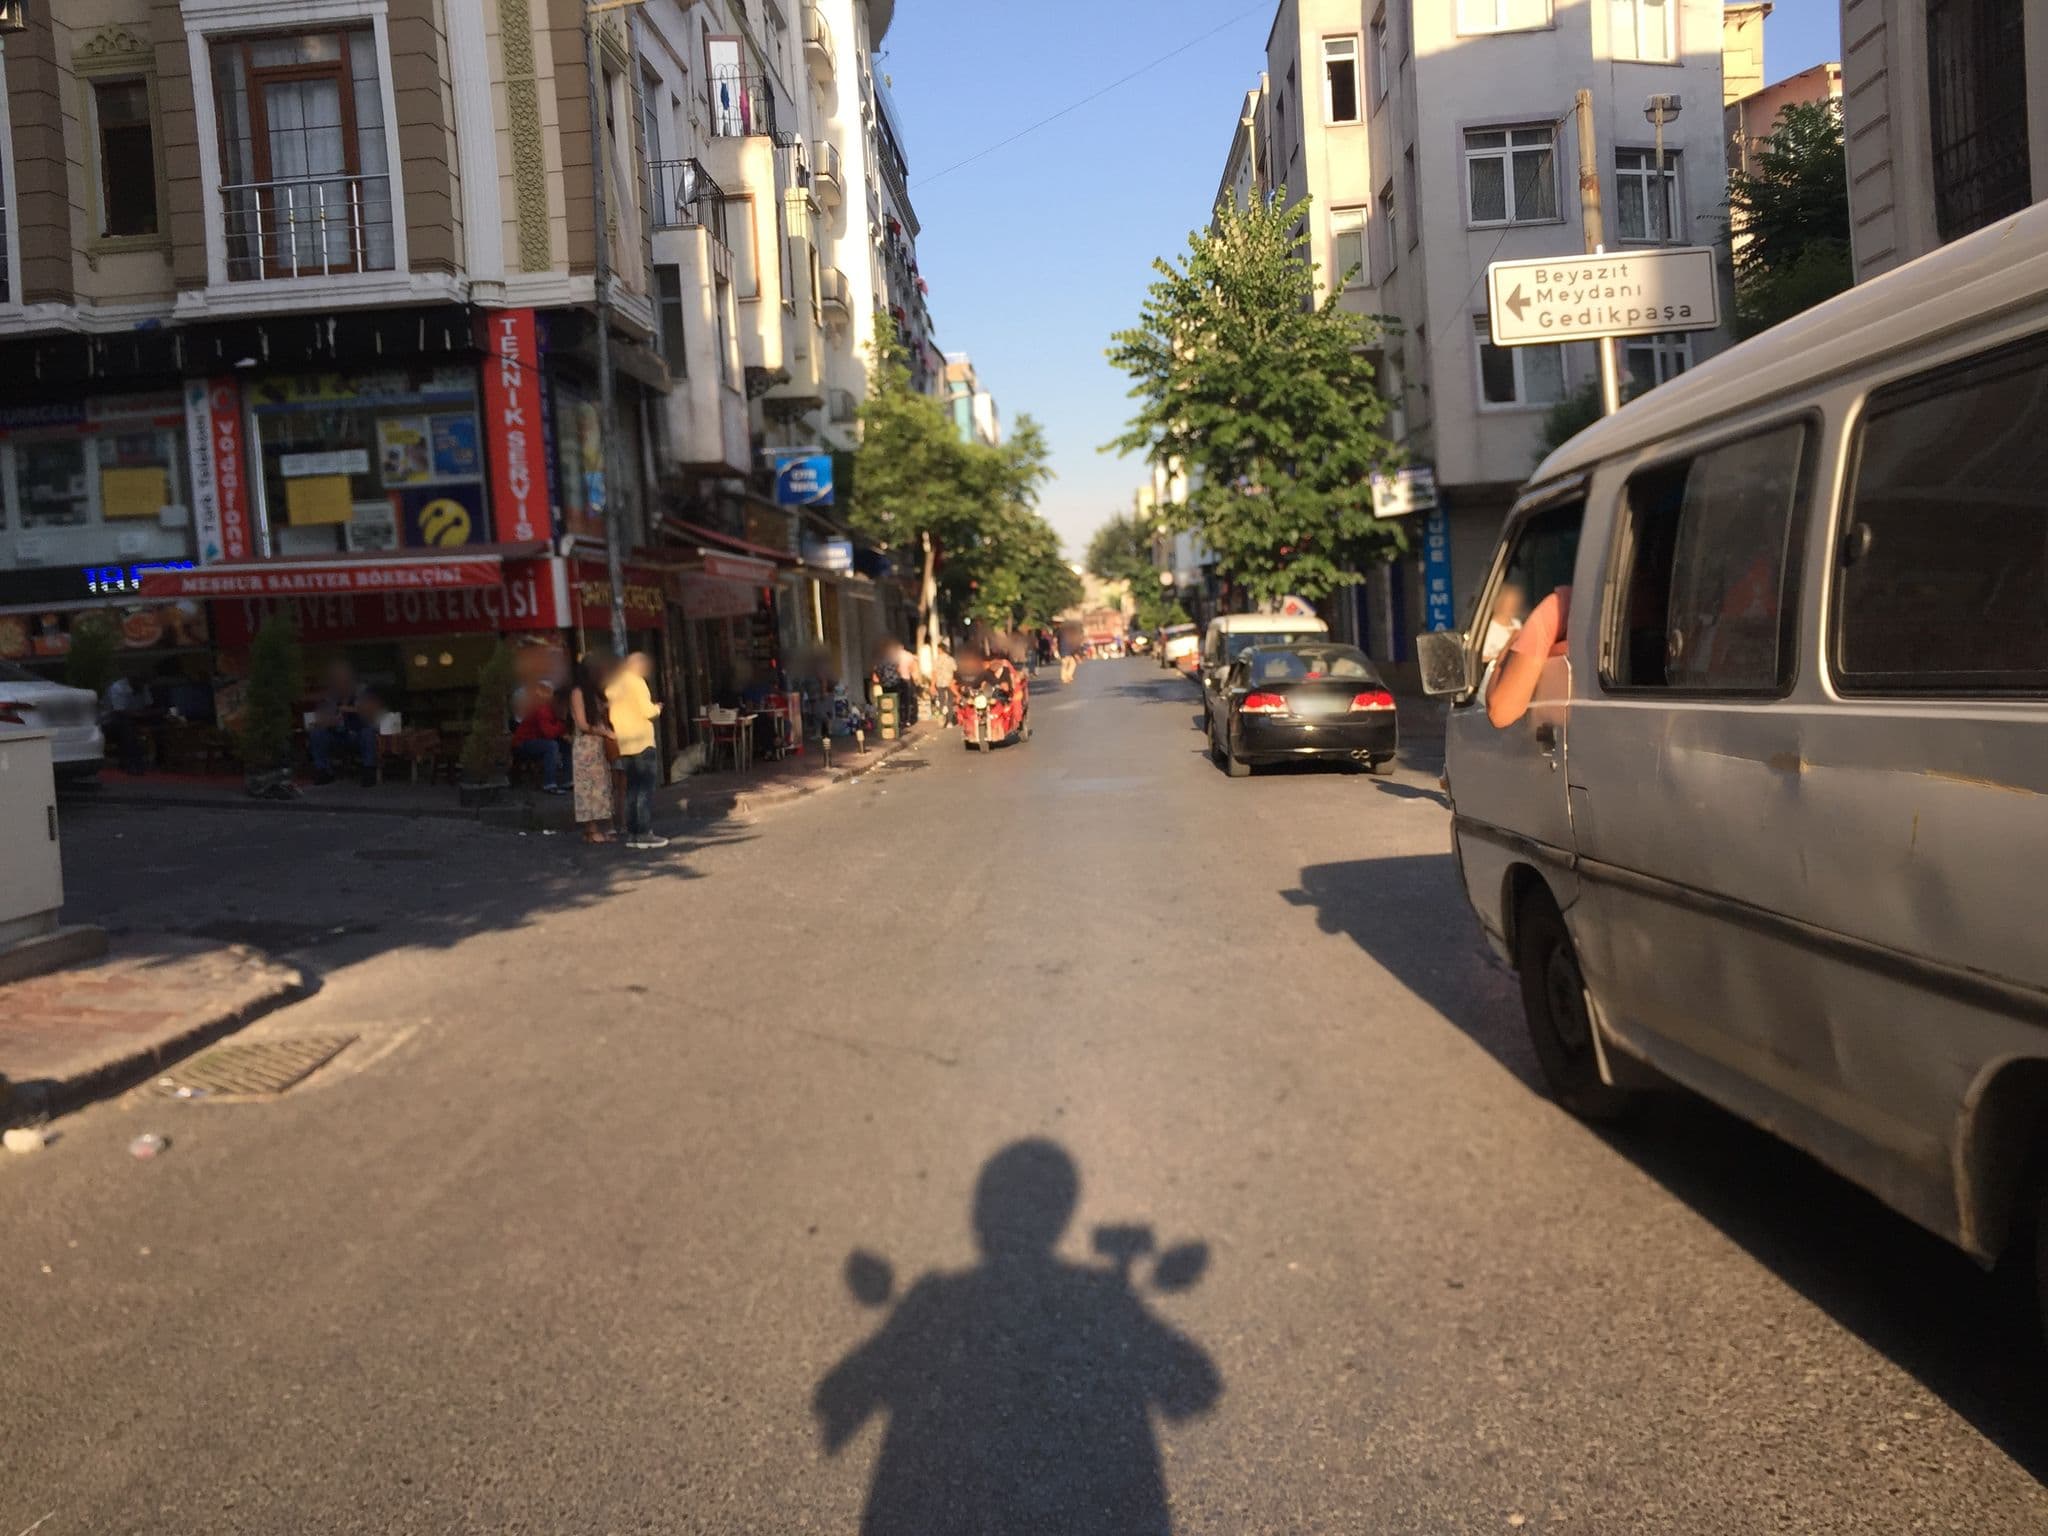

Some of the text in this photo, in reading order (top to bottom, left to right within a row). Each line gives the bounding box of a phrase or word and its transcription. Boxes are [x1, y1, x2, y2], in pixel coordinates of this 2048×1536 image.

[1536, 263, 1629, 285] Beyazıt
[1537, 284, 1641, 305] Meydanı
[1539, 304, 1692, 328] Gedikpaşa
